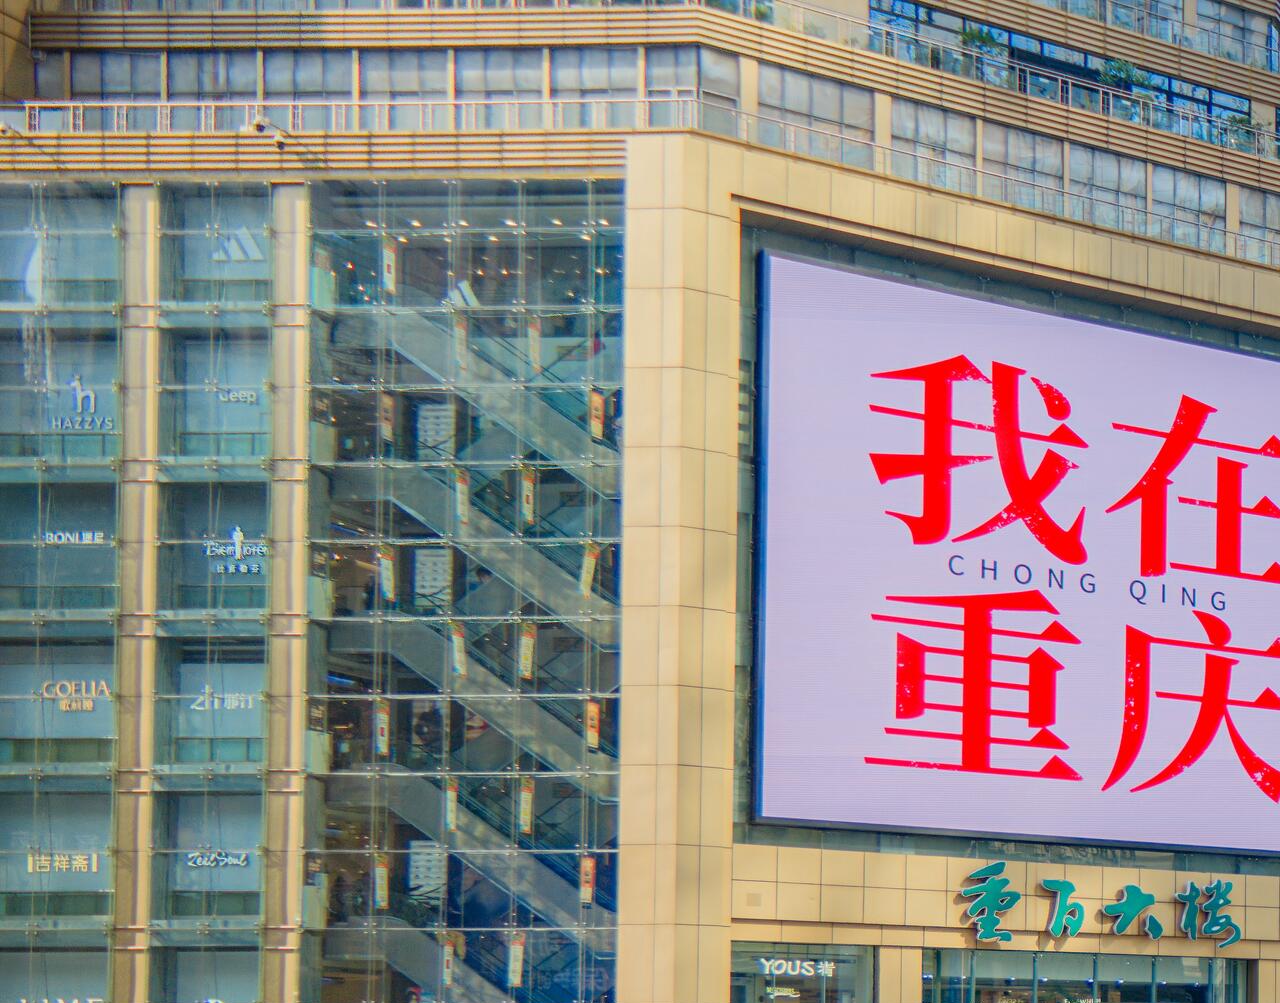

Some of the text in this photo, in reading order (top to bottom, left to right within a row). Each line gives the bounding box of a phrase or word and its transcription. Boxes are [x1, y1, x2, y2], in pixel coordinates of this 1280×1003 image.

[52, 416, 113, 430] HAZZYS
[948, 553, 1230, 613] CHONG QING
[43, 680, 111, 698] GOELIA
[760, 958, 815, 976] YOUS
